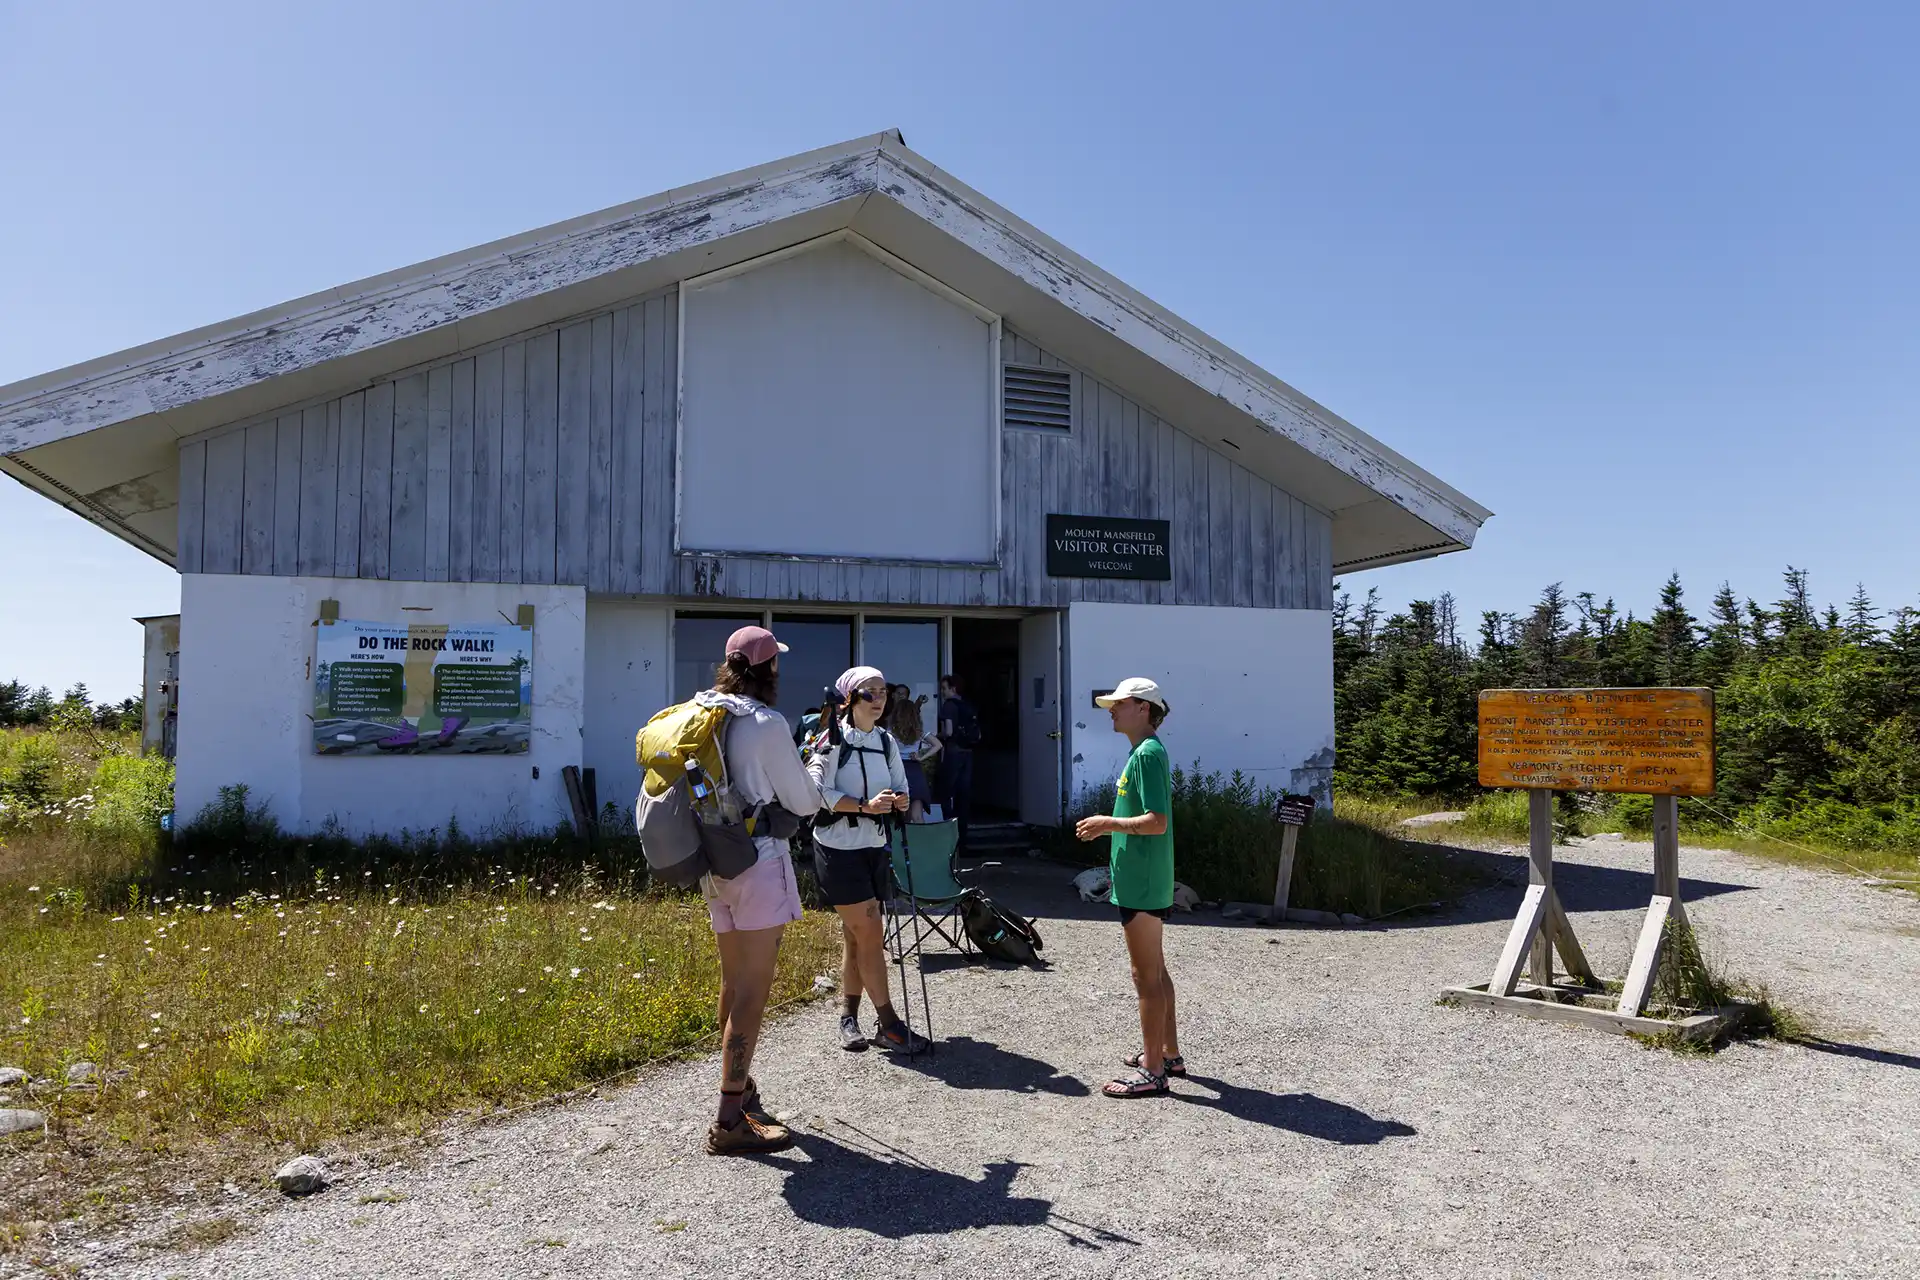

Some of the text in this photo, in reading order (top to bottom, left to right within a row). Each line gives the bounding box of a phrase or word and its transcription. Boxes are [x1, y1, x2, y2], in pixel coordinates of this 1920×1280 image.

[1064, 529, 1155, 540] MOUNT MANSFIELD
[1055, 540, 1164, 556] VISITOR CENTER
[1088, 561, 1133, 570] WELCOME
[359, 637, 494, 652] DO THE ROCK WALK!
[1524, 695, 1573, 703] WELCOME
[1484, 717, 1517, 725] MOUNT
[1525, 718, 1587, 726] MANSFIELD
[1657, 719, 1704, 727] CENTER
[1508, 762, 1677, 775] VERMONT'S HIGHEST PEAK
